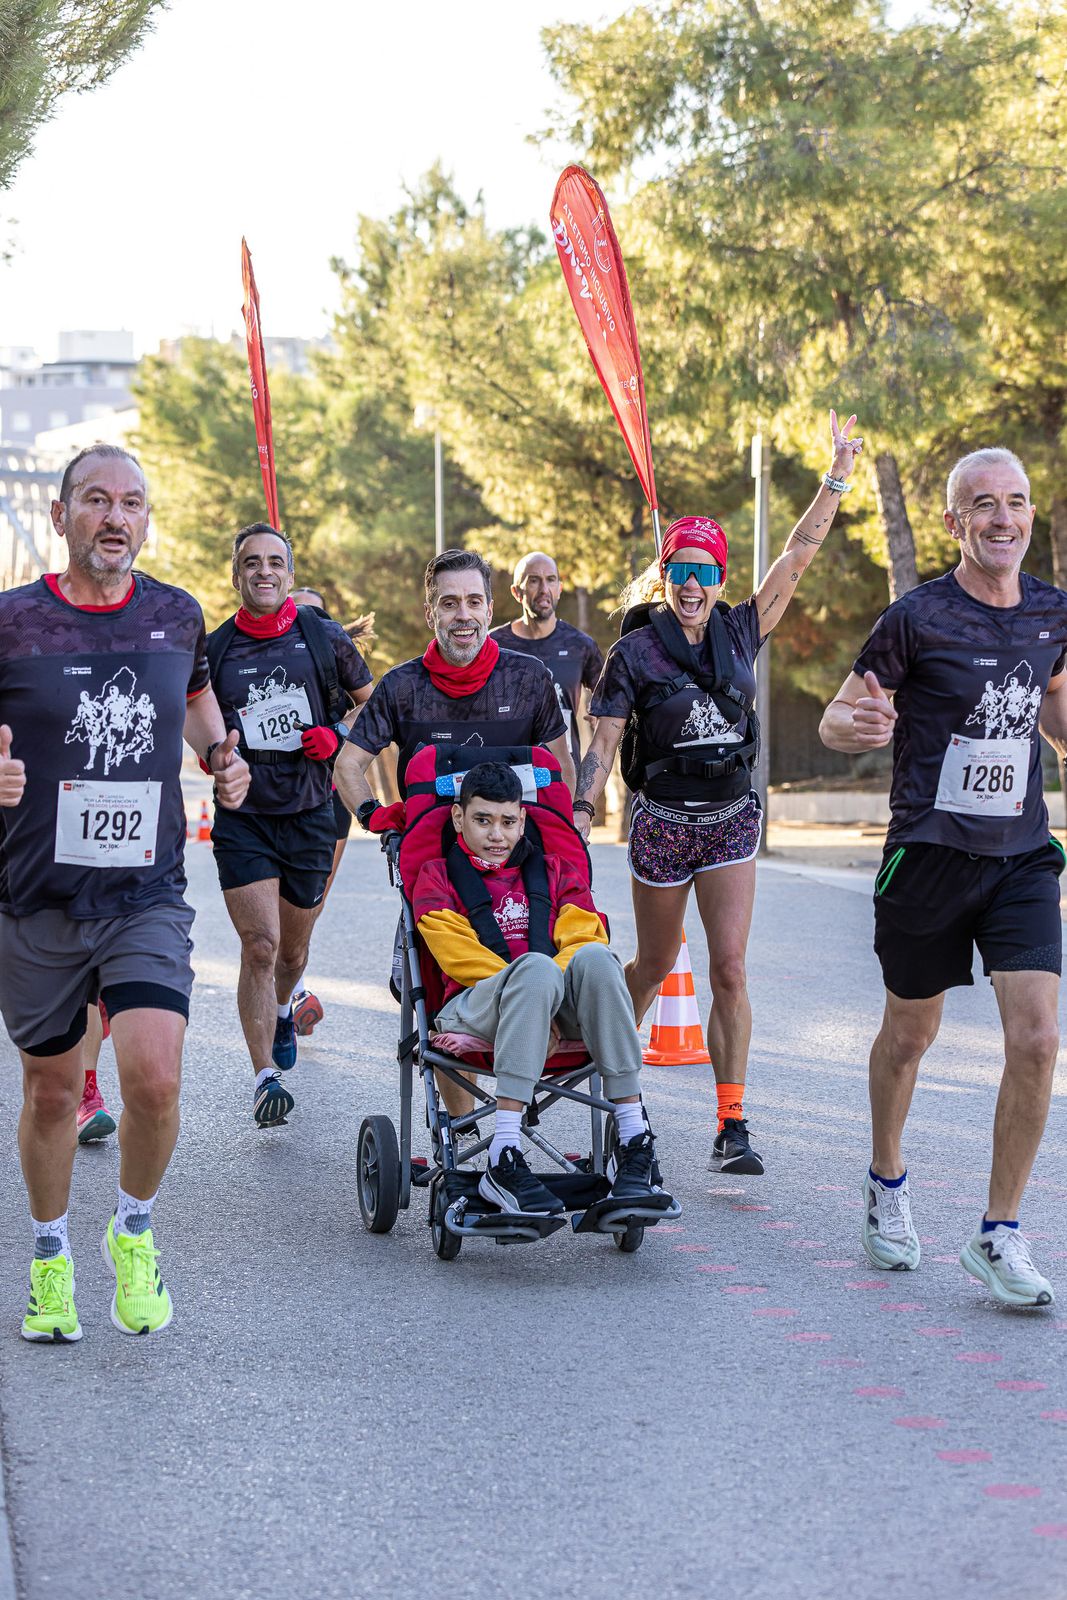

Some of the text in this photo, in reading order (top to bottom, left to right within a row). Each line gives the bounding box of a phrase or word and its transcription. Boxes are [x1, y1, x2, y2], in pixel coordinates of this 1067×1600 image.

[563, 204, 591, 267] ATLETISMO
[590, 267, 615, 331] INCLUSIVO
[962, 764, 1015, 793] 1286
[80, 810, 142, 841] 1292
[649, 803, 689, 822] balance
[697, 815, 718, 823] new
